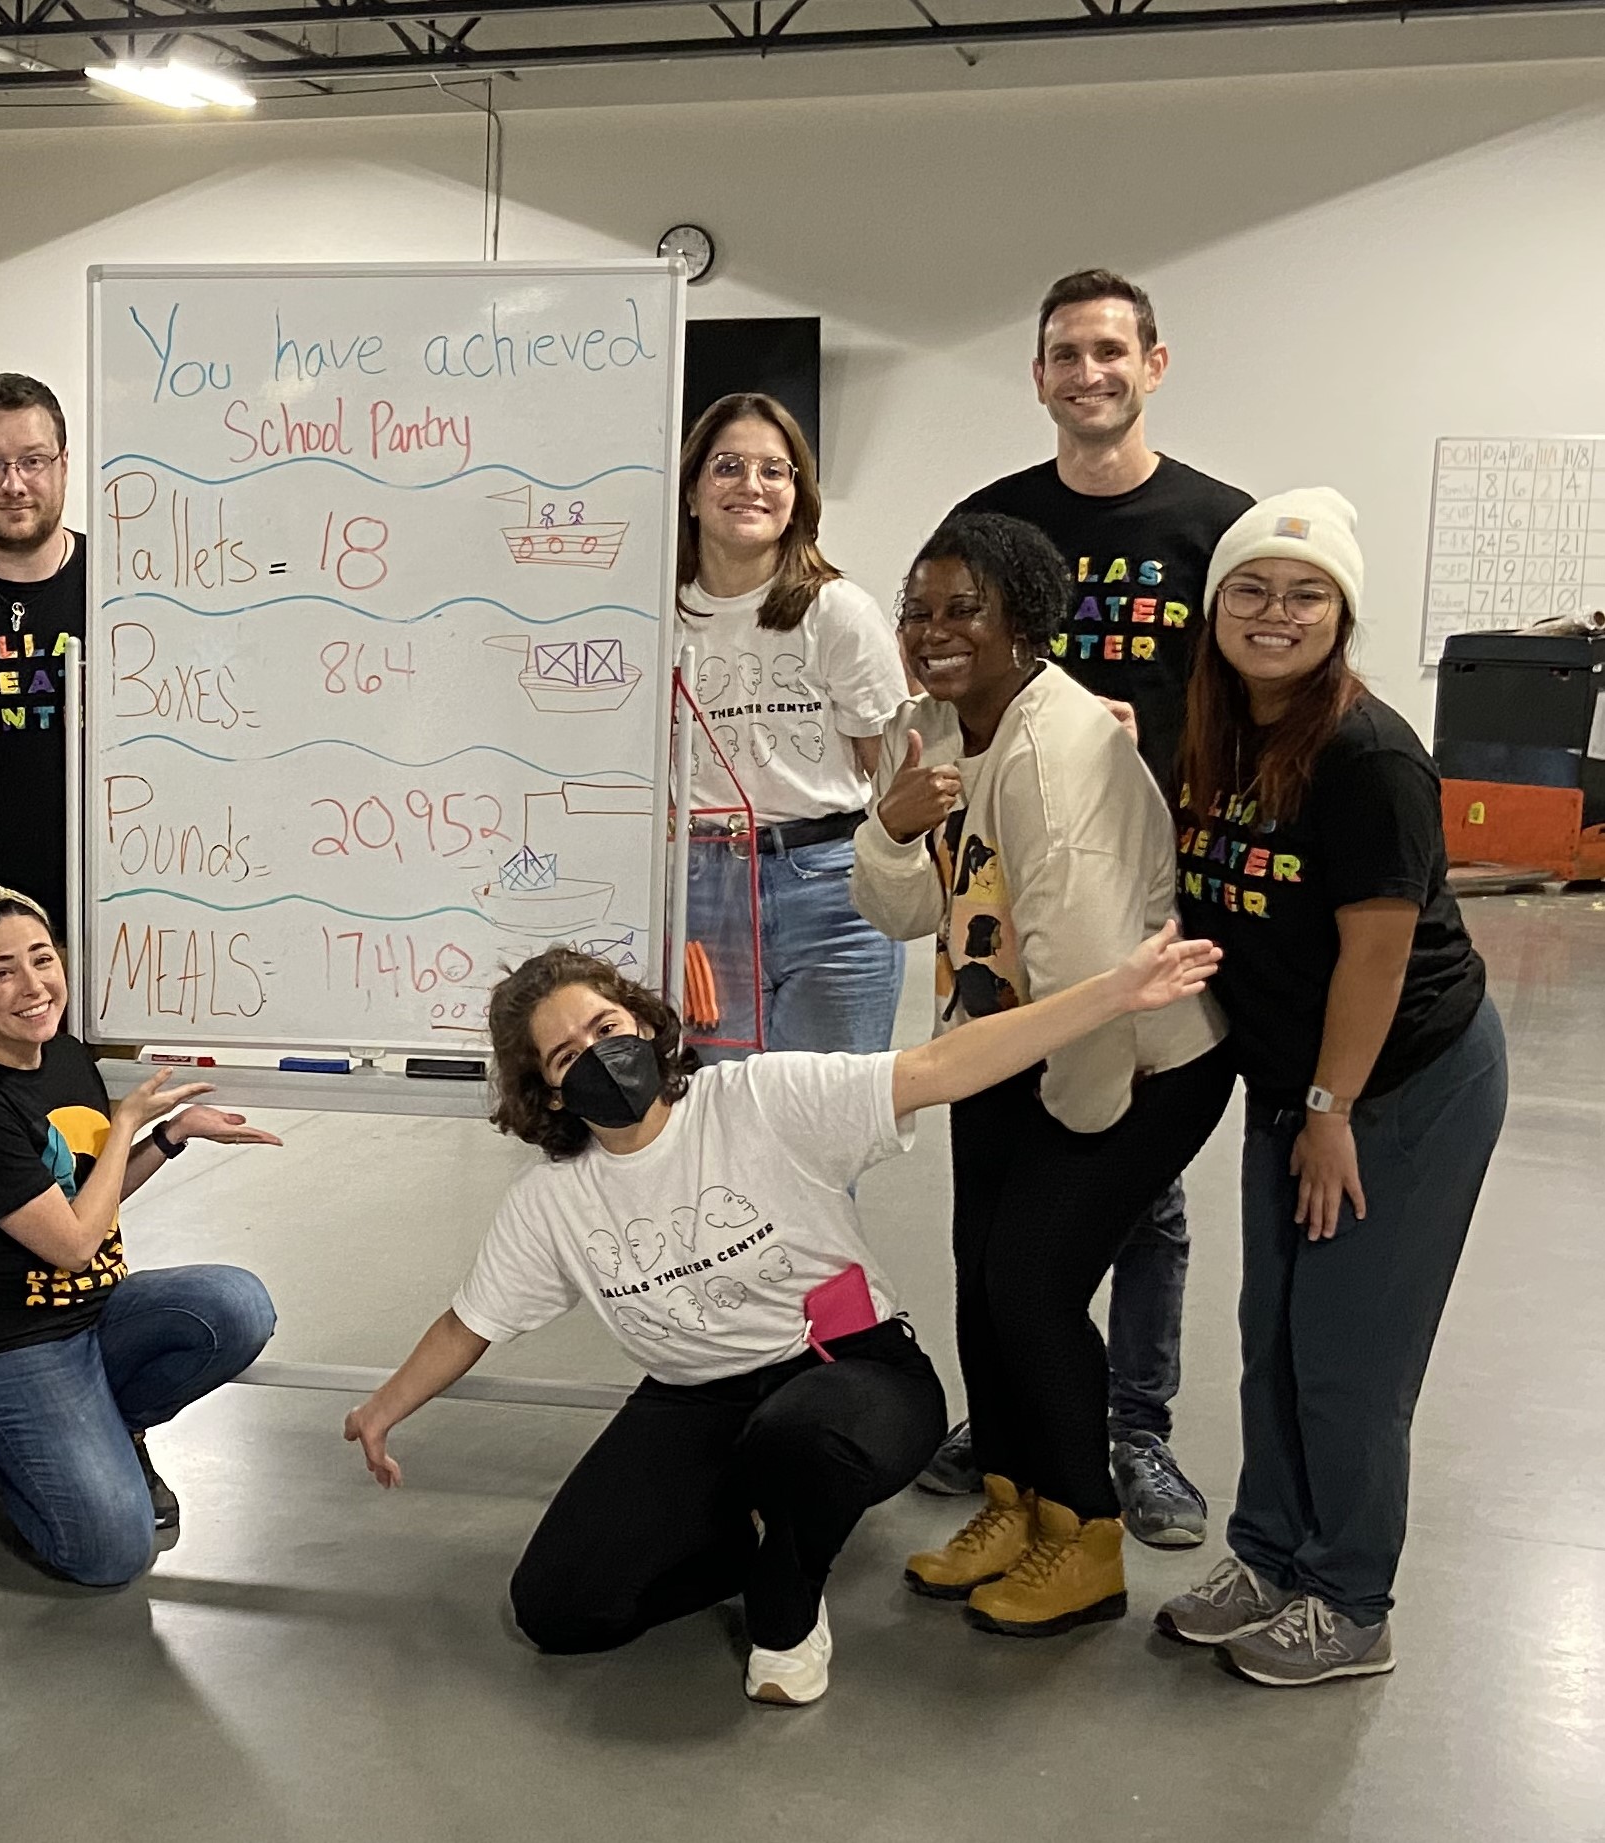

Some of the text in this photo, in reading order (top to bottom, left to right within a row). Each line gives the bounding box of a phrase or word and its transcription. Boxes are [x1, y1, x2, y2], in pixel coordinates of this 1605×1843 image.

[128, 298, 656, 403] You have achieved
[224, 396, 472, 474] School Pantry
[1565, 444, 1590, 470] 11/8
[1485, 472, 1498, 498] 8
[1512, 477, 1526, 497] 6
[1566, 472, 1582, 498] 4
[104, 471, 258, 590] Pallets
[321, 511, 389, 590] 18
[1481, 502, 1499, 529] 14
[1507, 504, 1523, 528] 6
[1532, 504, 1554, 529] 17
[1566, 504, 1581, 529] 11
[1476, 532, 1496, 555] 24
[1505, 533, 1520, 554] 5
[1560, 533, 1579, 554] 21
[1076, 556, 1164, 587] LAS
[1476, 559, 1495, 581] 17
[1503, 559, 1516, 582] 9
[1558, 560, 1578, 582] 22
[1073, 595, 1190, 629] ATER
[1475, 590, 1490, 612] 7
[1500, 586, 1515, 610] 4
[1049, 632, 1157, 661] NTER
[320, 641, 416, 693] 864
[767, 701, 823, 714] CENTER
[310, 789, 512, 863] 20,952
[653, 1258, 714, 1287] THEATER
[717, 1222, 775, 1263] CENTER
